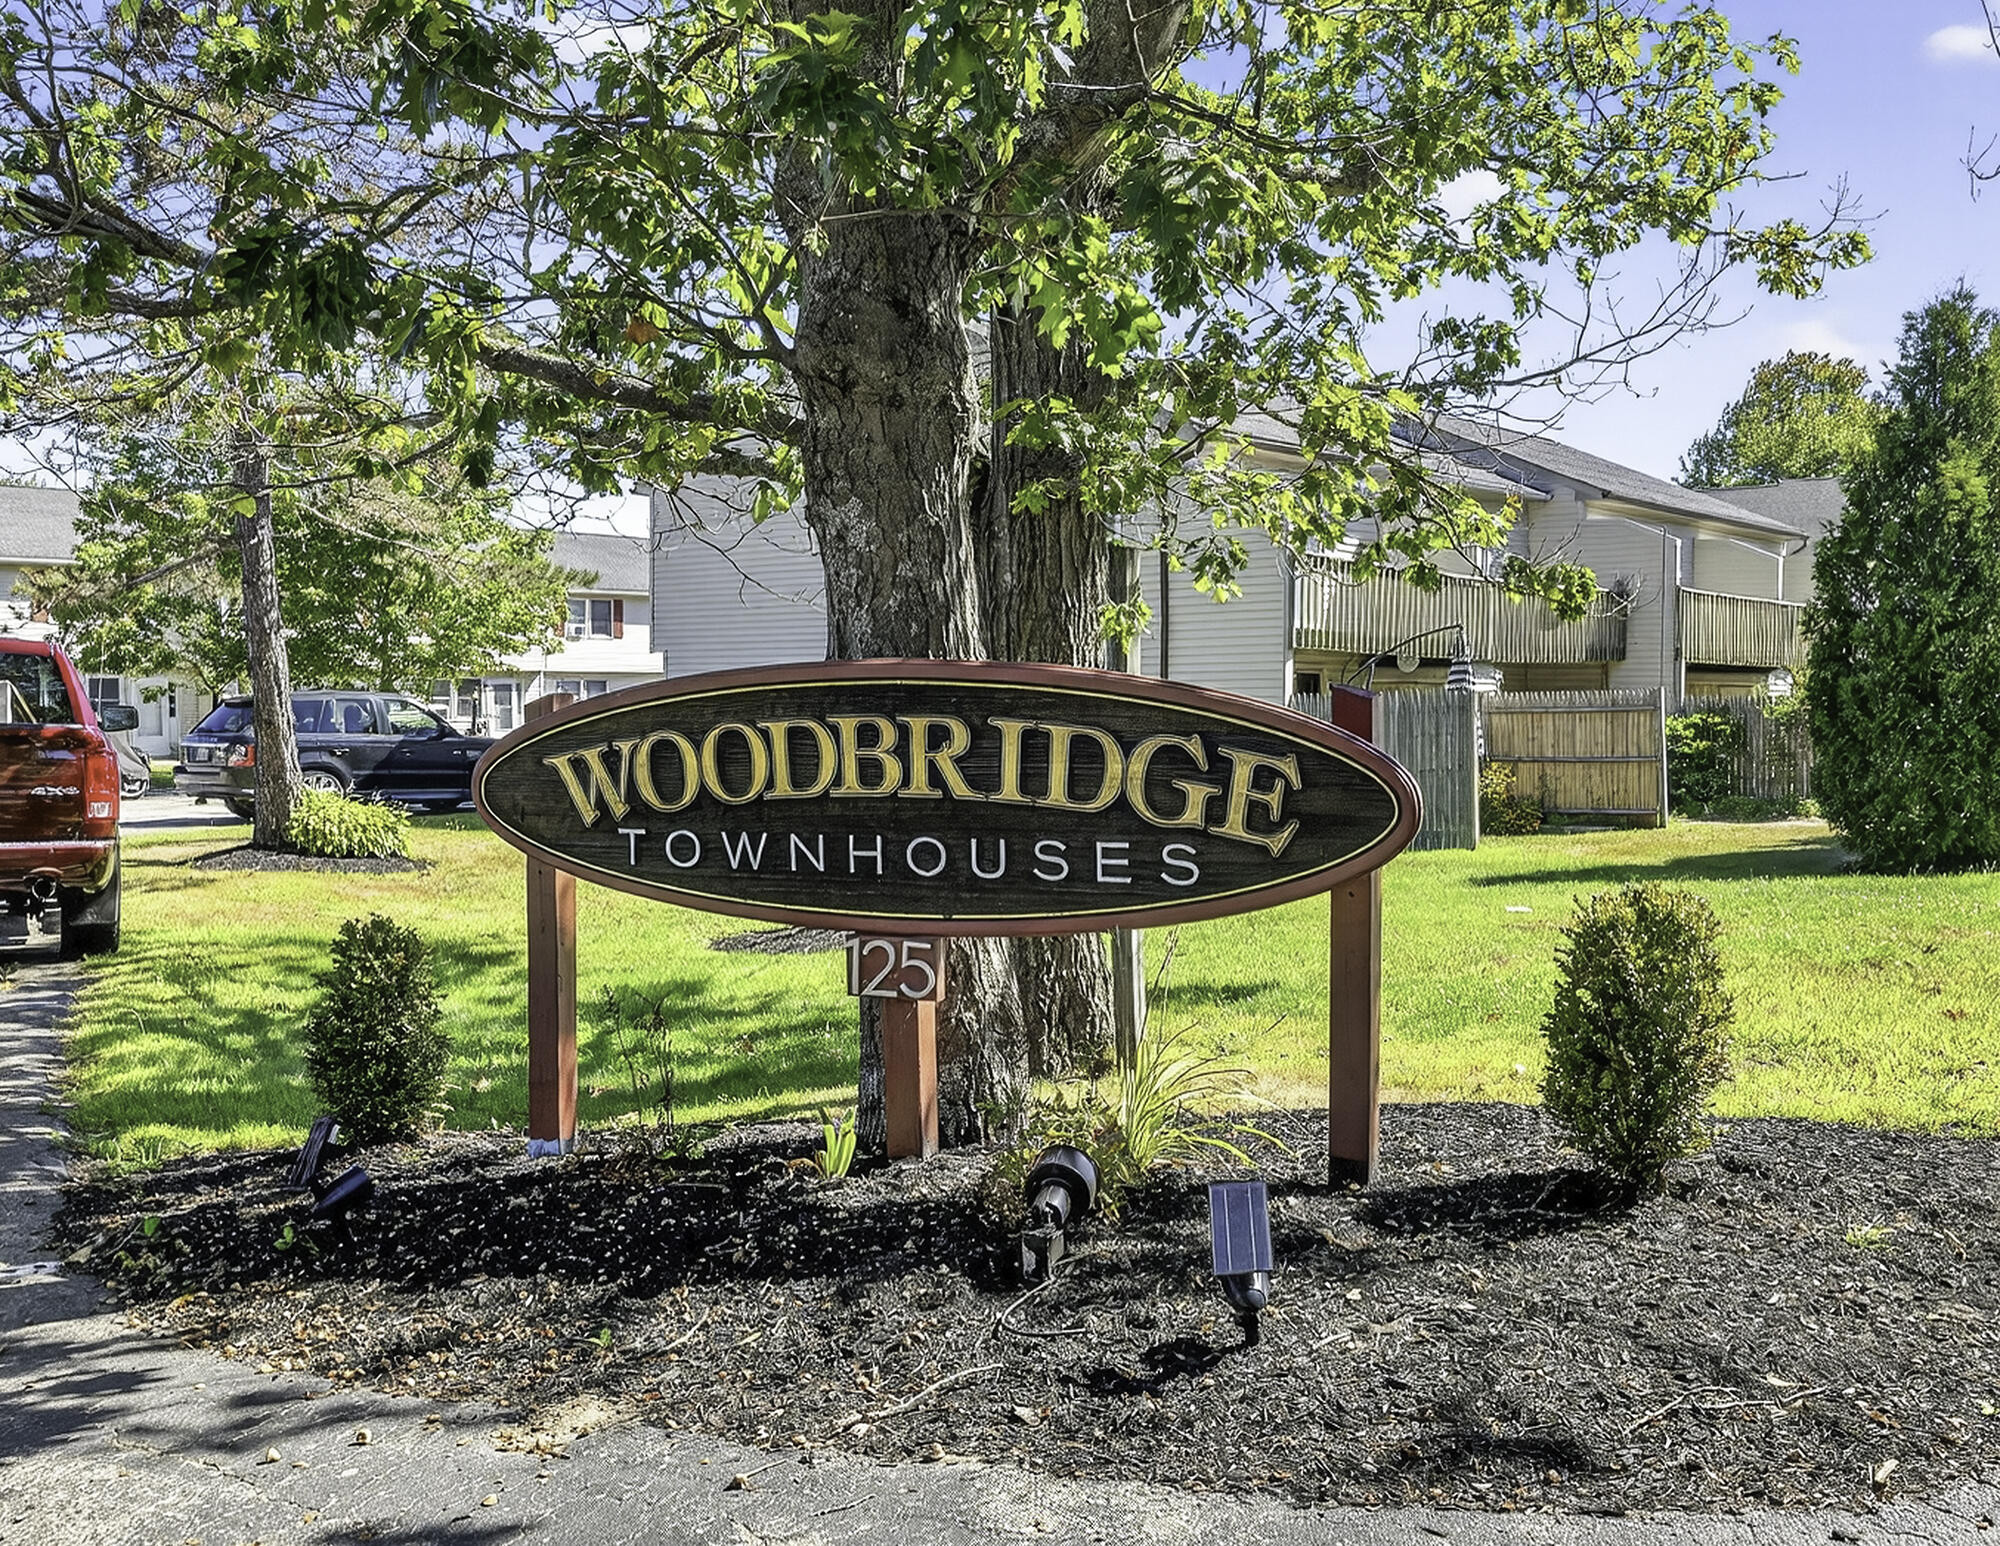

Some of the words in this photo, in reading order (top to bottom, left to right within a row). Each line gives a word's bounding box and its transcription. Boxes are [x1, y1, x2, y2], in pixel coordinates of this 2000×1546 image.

[543, 713, 1302, 858] WOODBRIDGE
[618, 827, 1201, 887] TOWNHOUSES
[845, 937, 936, 999] 125
